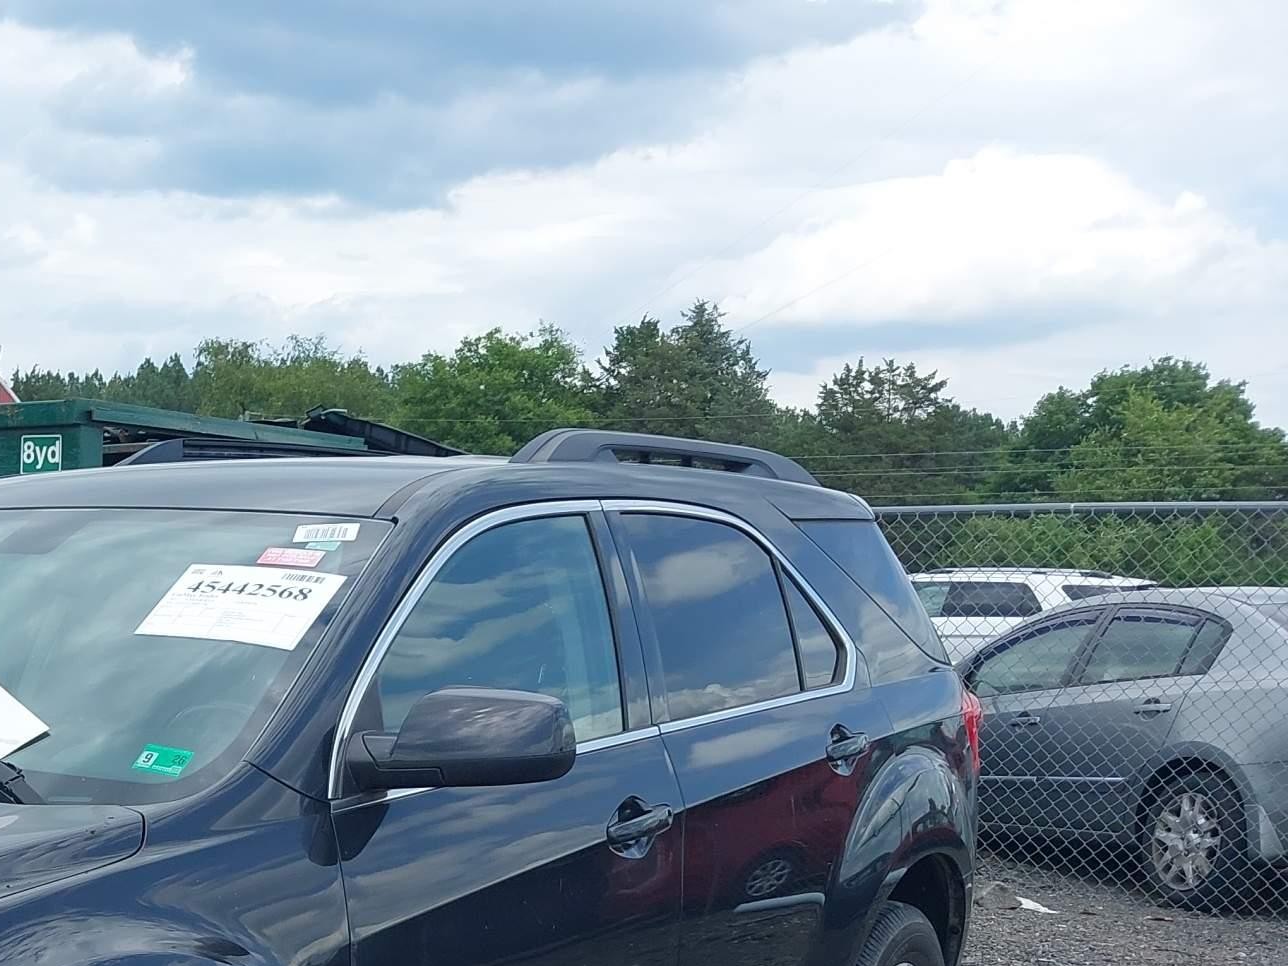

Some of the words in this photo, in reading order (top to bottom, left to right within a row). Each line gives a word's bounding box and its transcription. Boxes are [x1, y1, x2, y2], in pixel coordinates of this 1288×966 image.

[23, 440, 60, 469] 8yd
[187, 580, 313, 601] 45442568
[142, 752, 154, 764] 9
